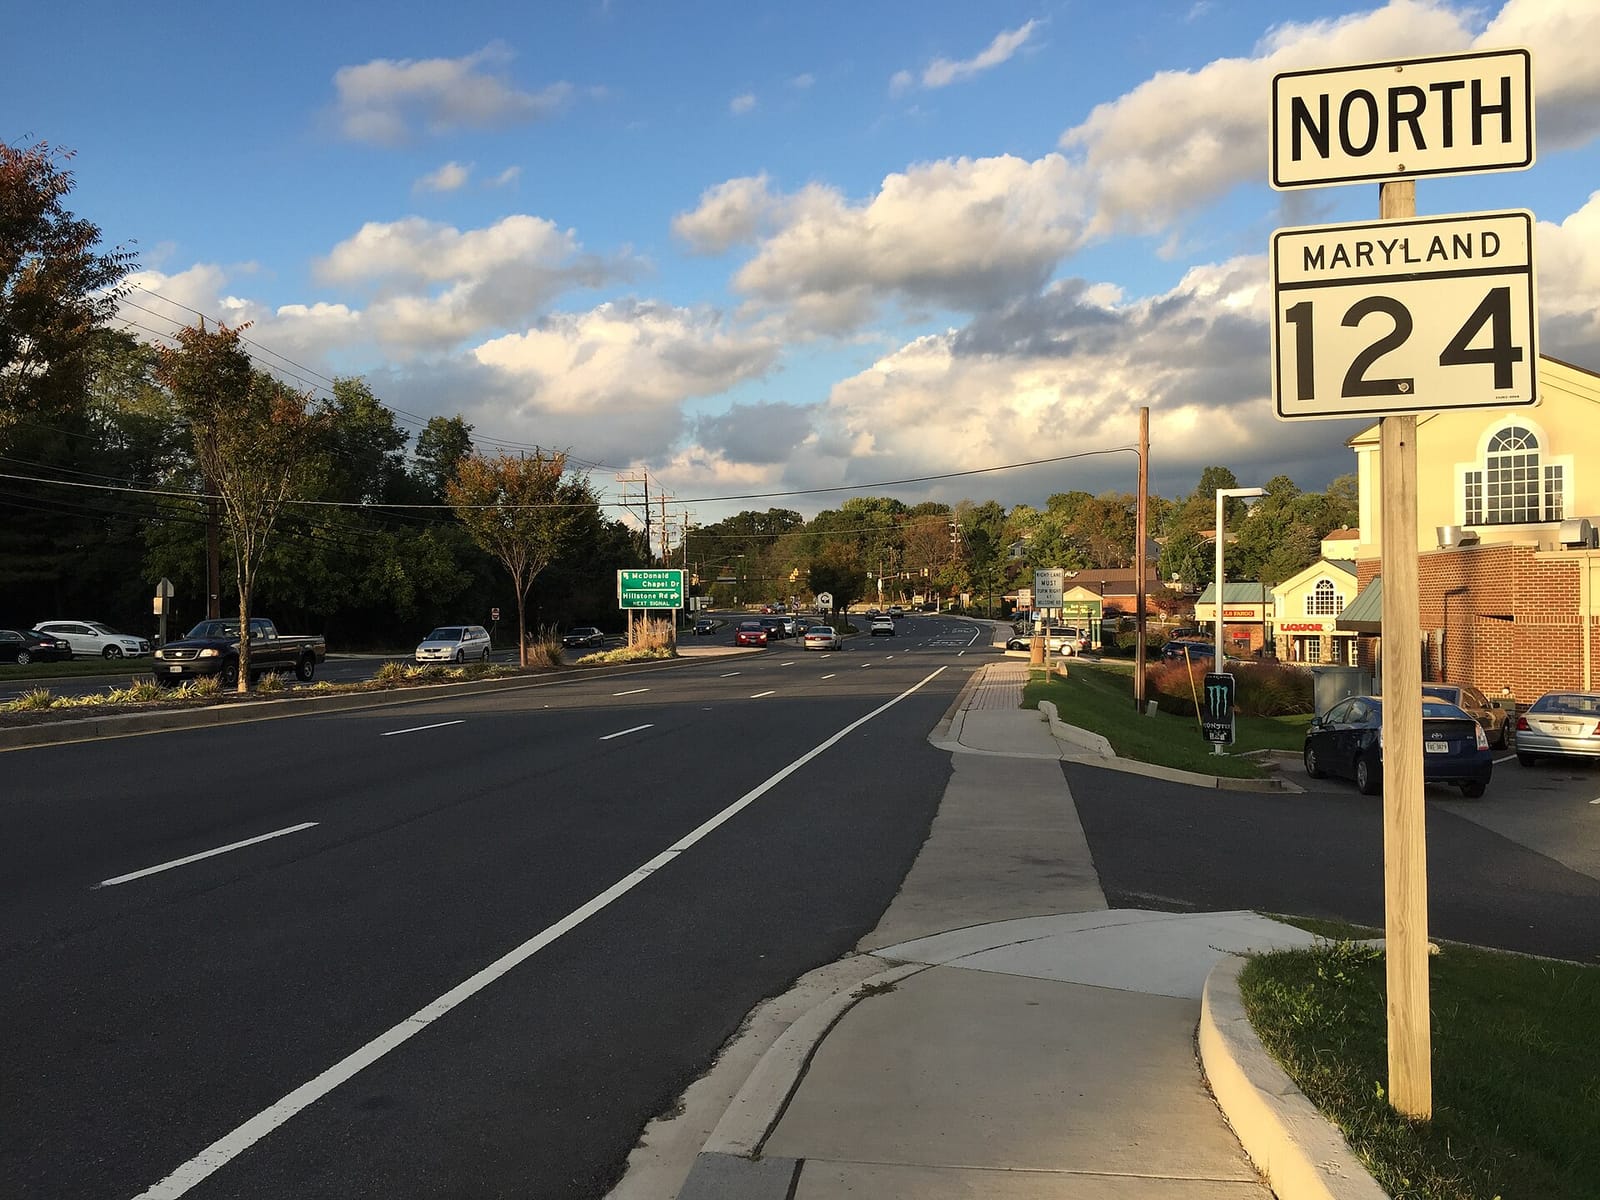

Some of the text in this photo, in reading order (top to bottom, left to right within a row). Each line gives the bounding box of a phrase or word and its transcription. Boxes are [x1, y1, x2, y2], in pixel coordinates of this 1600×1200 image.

[1291, 76, 1512, 161] NORTH
[1303, 231, 1501, 271] MARYLAND
[1285, 286, 1523, 401] 124
[1280, 624, 1324, 632] LIQUOR
